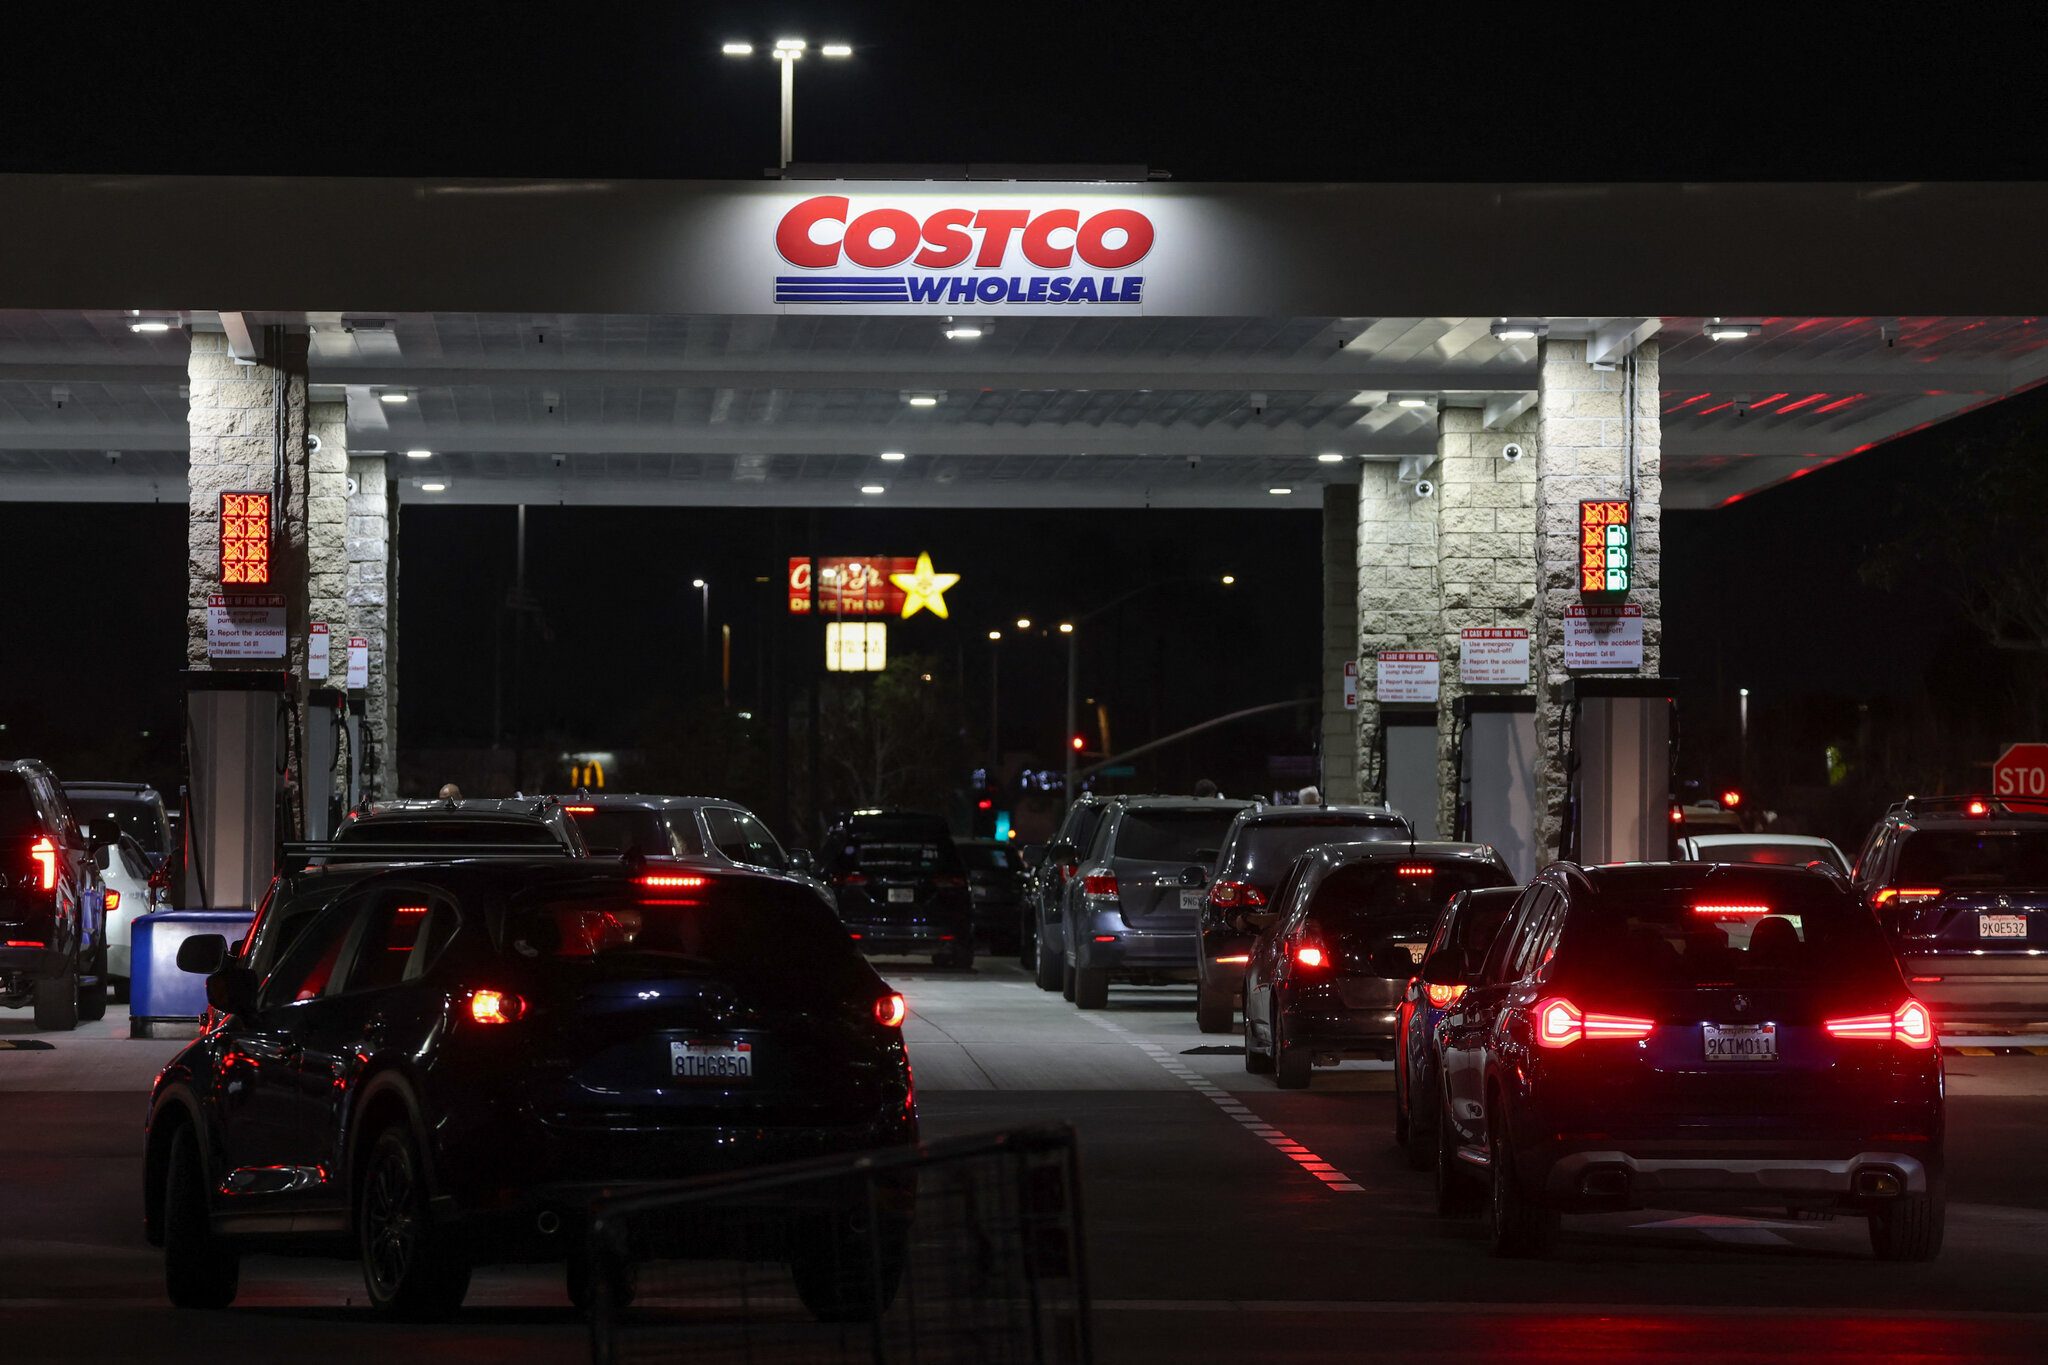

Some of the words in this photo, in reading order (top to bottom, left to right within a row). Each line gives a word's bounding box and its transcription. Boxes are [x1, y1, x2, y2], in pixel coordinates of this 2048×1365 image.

[775, 195, 1155, 269] COSTCO
[907, 276, 1143, 303] WHOLESALE
[1999, 767, 2047, 795] STO
[1982, 922, 2025, 934] 9KQE532
[675, 1056, 748, 1077] 8THG850
